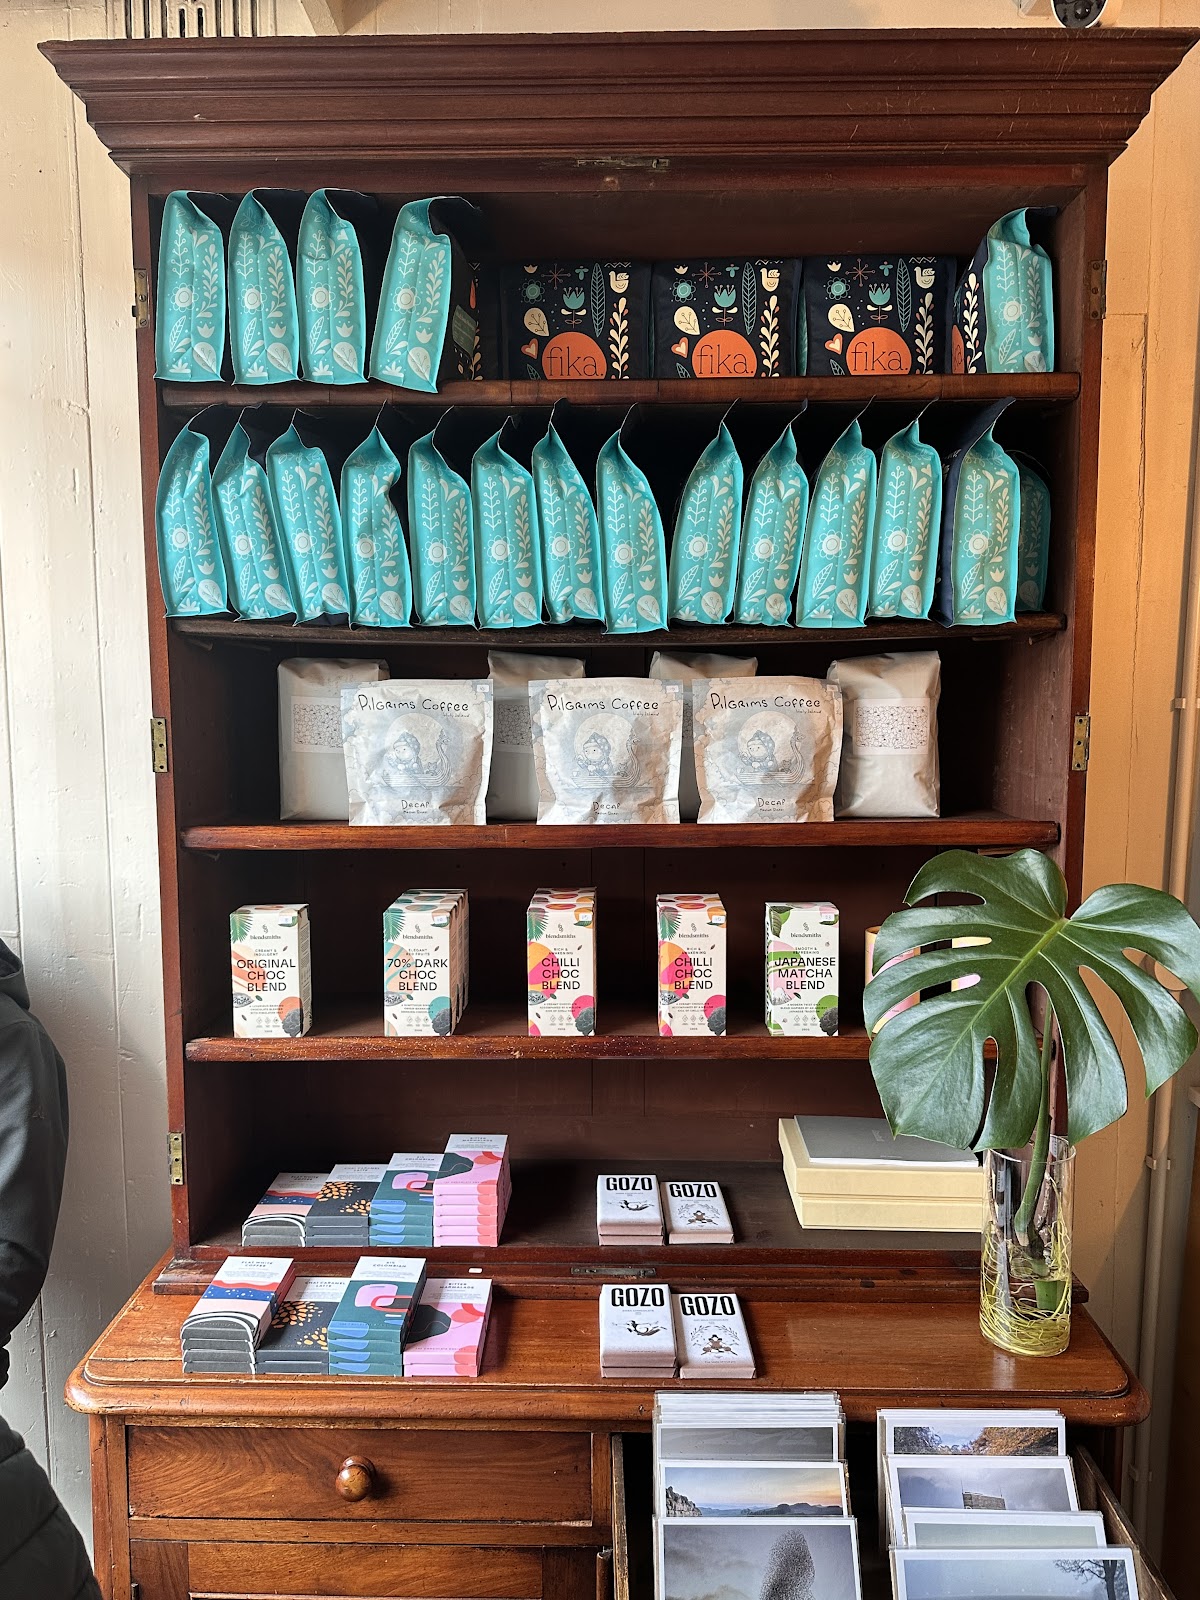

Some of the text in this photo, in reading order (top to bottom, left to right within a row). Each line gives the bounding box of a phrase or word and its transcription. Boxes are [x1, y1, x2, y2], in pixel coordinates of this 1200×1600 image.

[422, 698, 469, 712] Coffee
[611, 698, 659, 711] Coffee
[774, 696, 821, 709] Coffee
[757, 797, 786, 807] Decaf
[236, 959, 296, 969] ORIGINAL
[387, 958, 448, 968] 70% DARK
[541, 958, 580, 967] CHILLI
[674, 957, 713, 967] CHILLI
[774, 957, 836, 967] JAPANESE
[247, 971, 286, 980] CHOC
[399, 970, 437, 980] CHOC
[542, 969, 580, 979] CHOC
[675, 969, 712, 978] CHOC
[778, 969, 833, 978] MATCHA
[247, 982, 287, 992] BLEND
[398, 982, 438, 991] BLEND
[541, 981, 580, 990] BLEND
[674, 981, 713, 990] BLEND
[786, 981, 825, 990] BLEND
[606, 1177, 653, 1191] GOZO
[669, 1183, 717, 1198] GOZO
[611, 1287, 665, 1307] GOZO
[680, 1296, 736, 1316] GOZO
